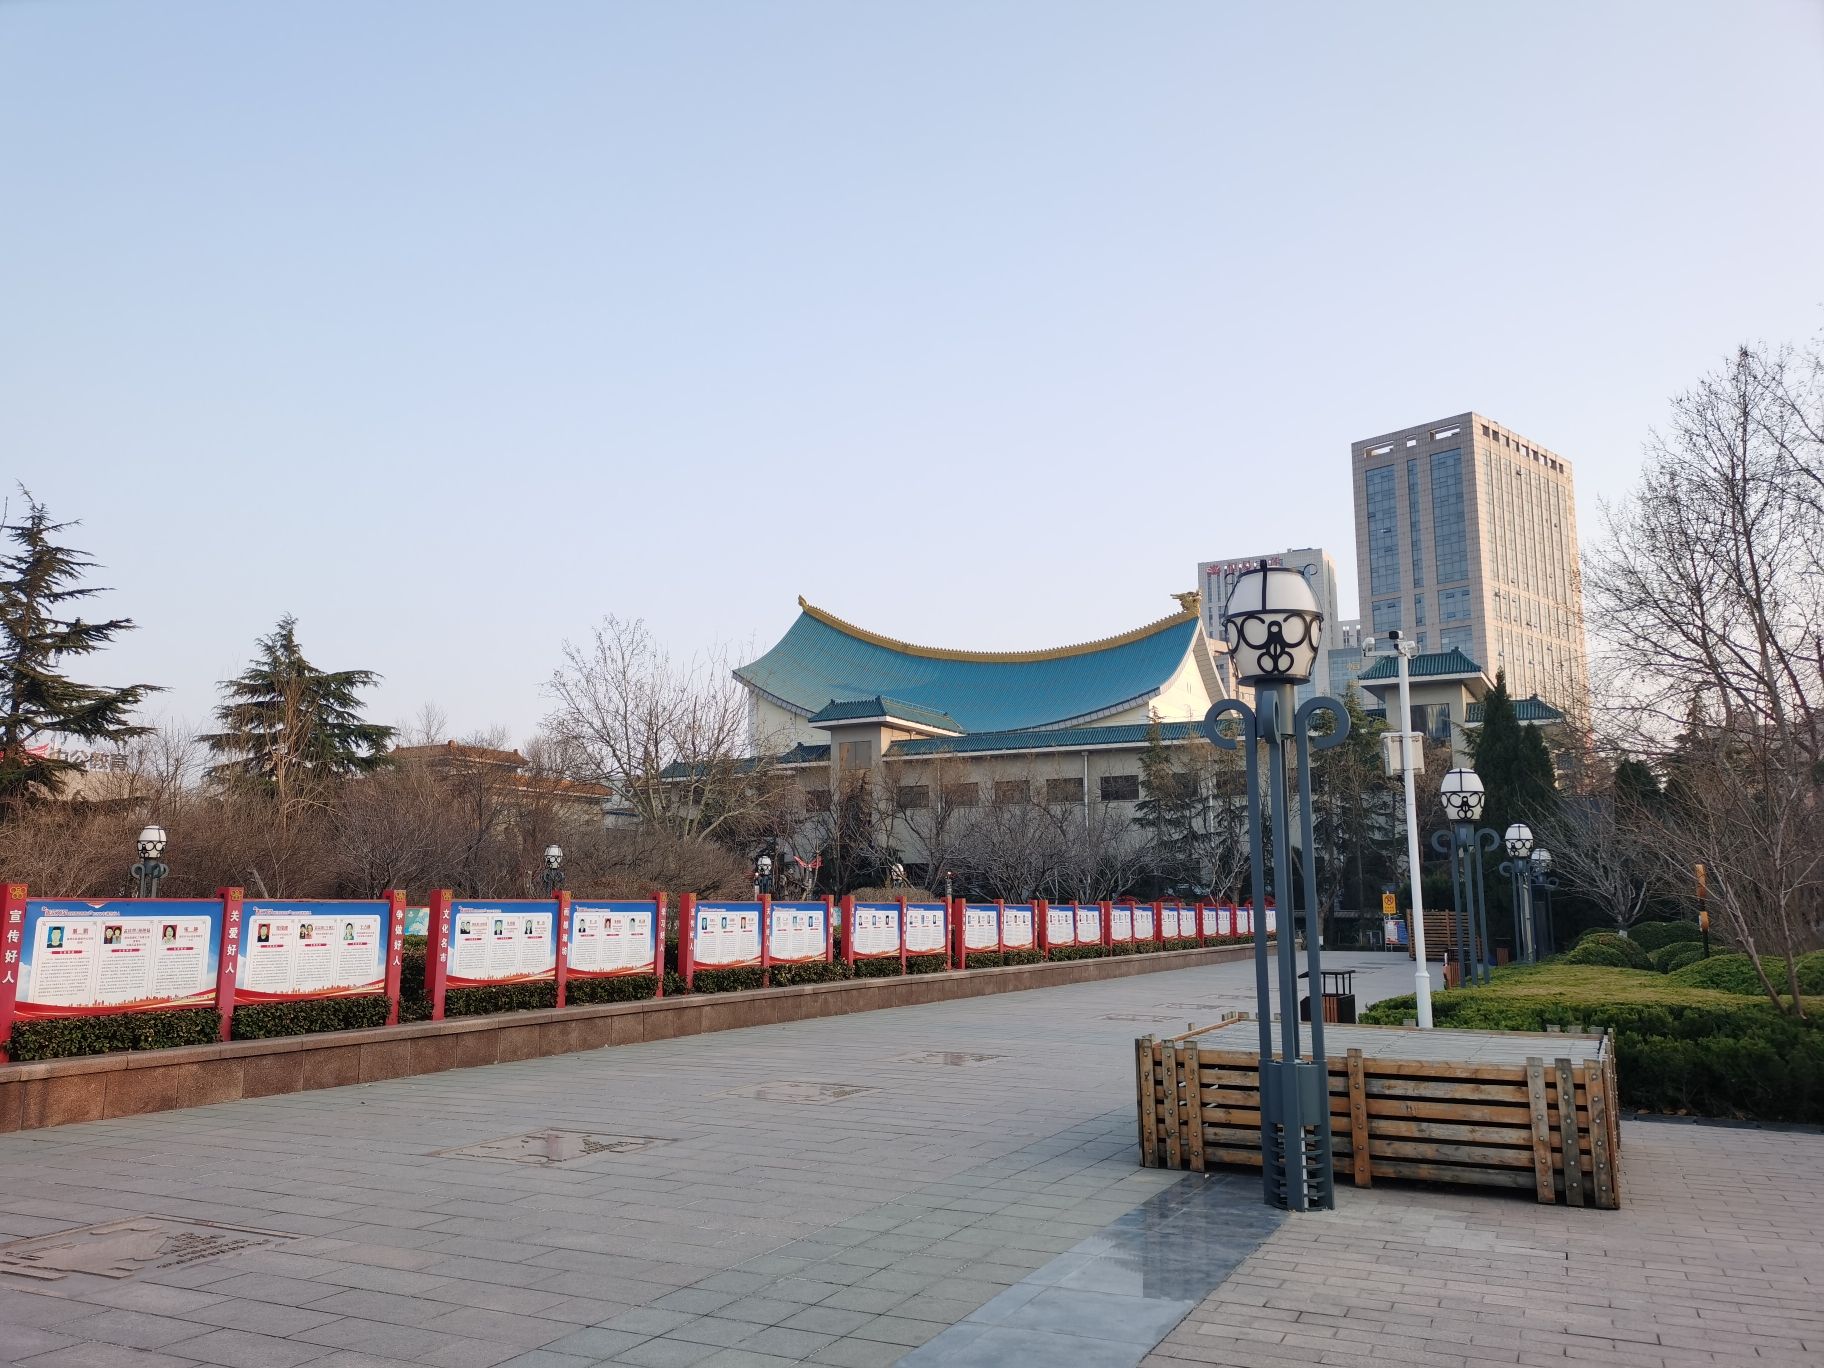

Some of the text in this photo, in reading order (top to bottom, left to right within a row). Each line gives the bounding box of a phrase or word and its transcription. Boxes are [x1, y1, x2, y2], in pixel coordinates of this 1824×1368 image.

[2, 909, 25, 985] 宣传好人
[225, 910, 240, 974] 关爱好人
[392, 909, 404, 967] 争做好人
[440, 908, 450, 962] 文化名市
